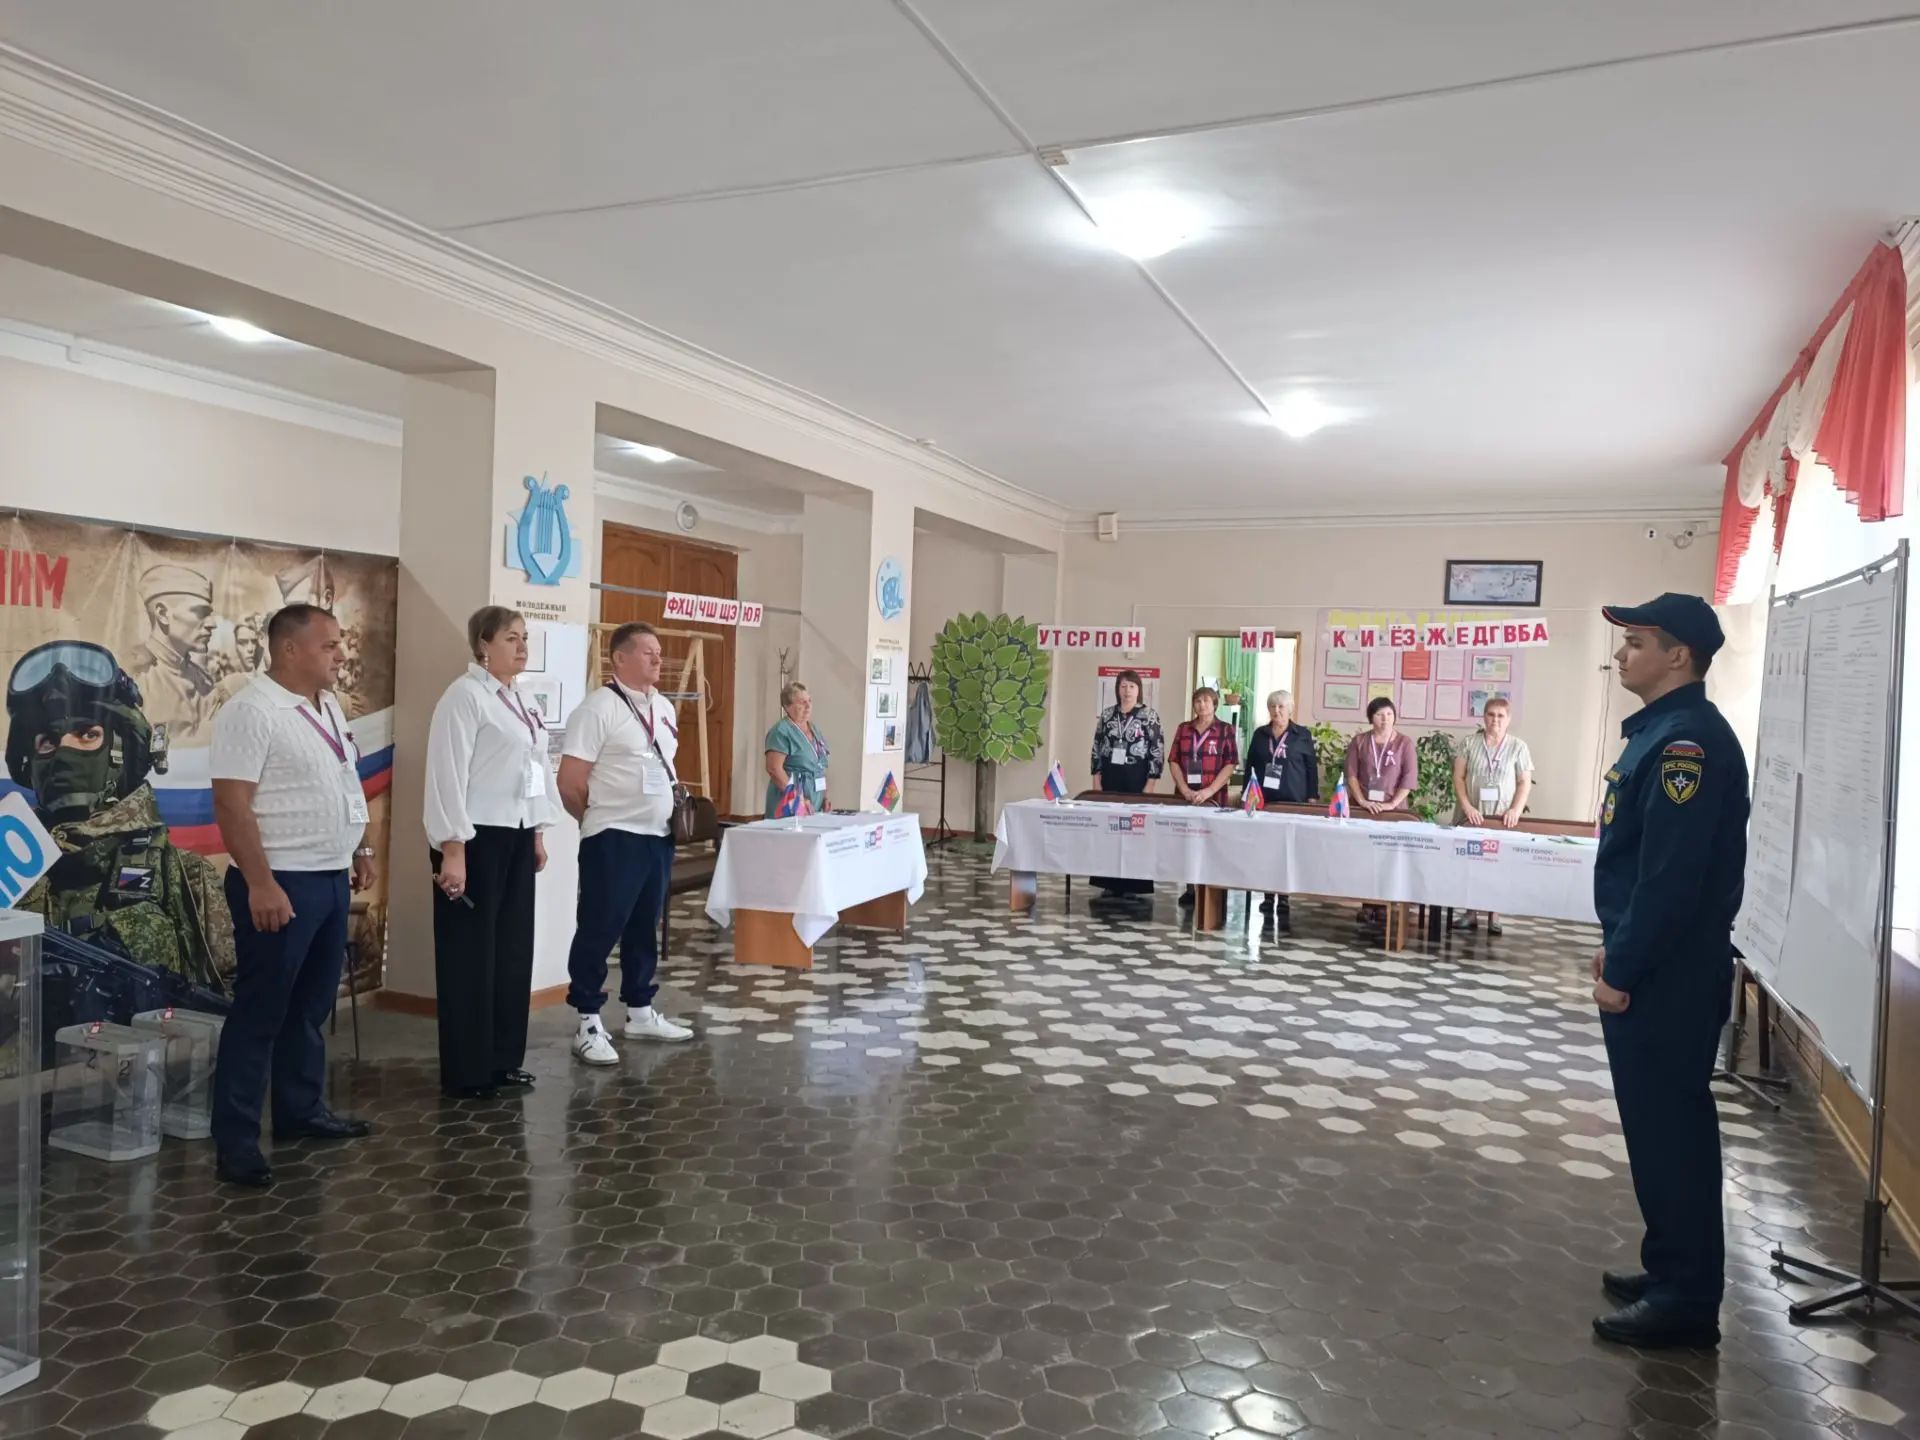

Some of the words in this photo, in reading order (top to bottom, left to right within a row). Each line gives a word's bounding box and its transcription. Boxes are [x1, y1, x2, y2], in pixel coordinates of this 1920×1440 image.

[0, 549, 69, 609] ИМ
[524, 611, 559, 620] ПРОСПЕКТ
[1132, 816, 1143, 825] 20
[1456, 847, 1466, 856] 18
[1469, 843, 1480, 853] 19
[1483, 840, 1497, 850] 20
[139, 876, 151, 888] Z
